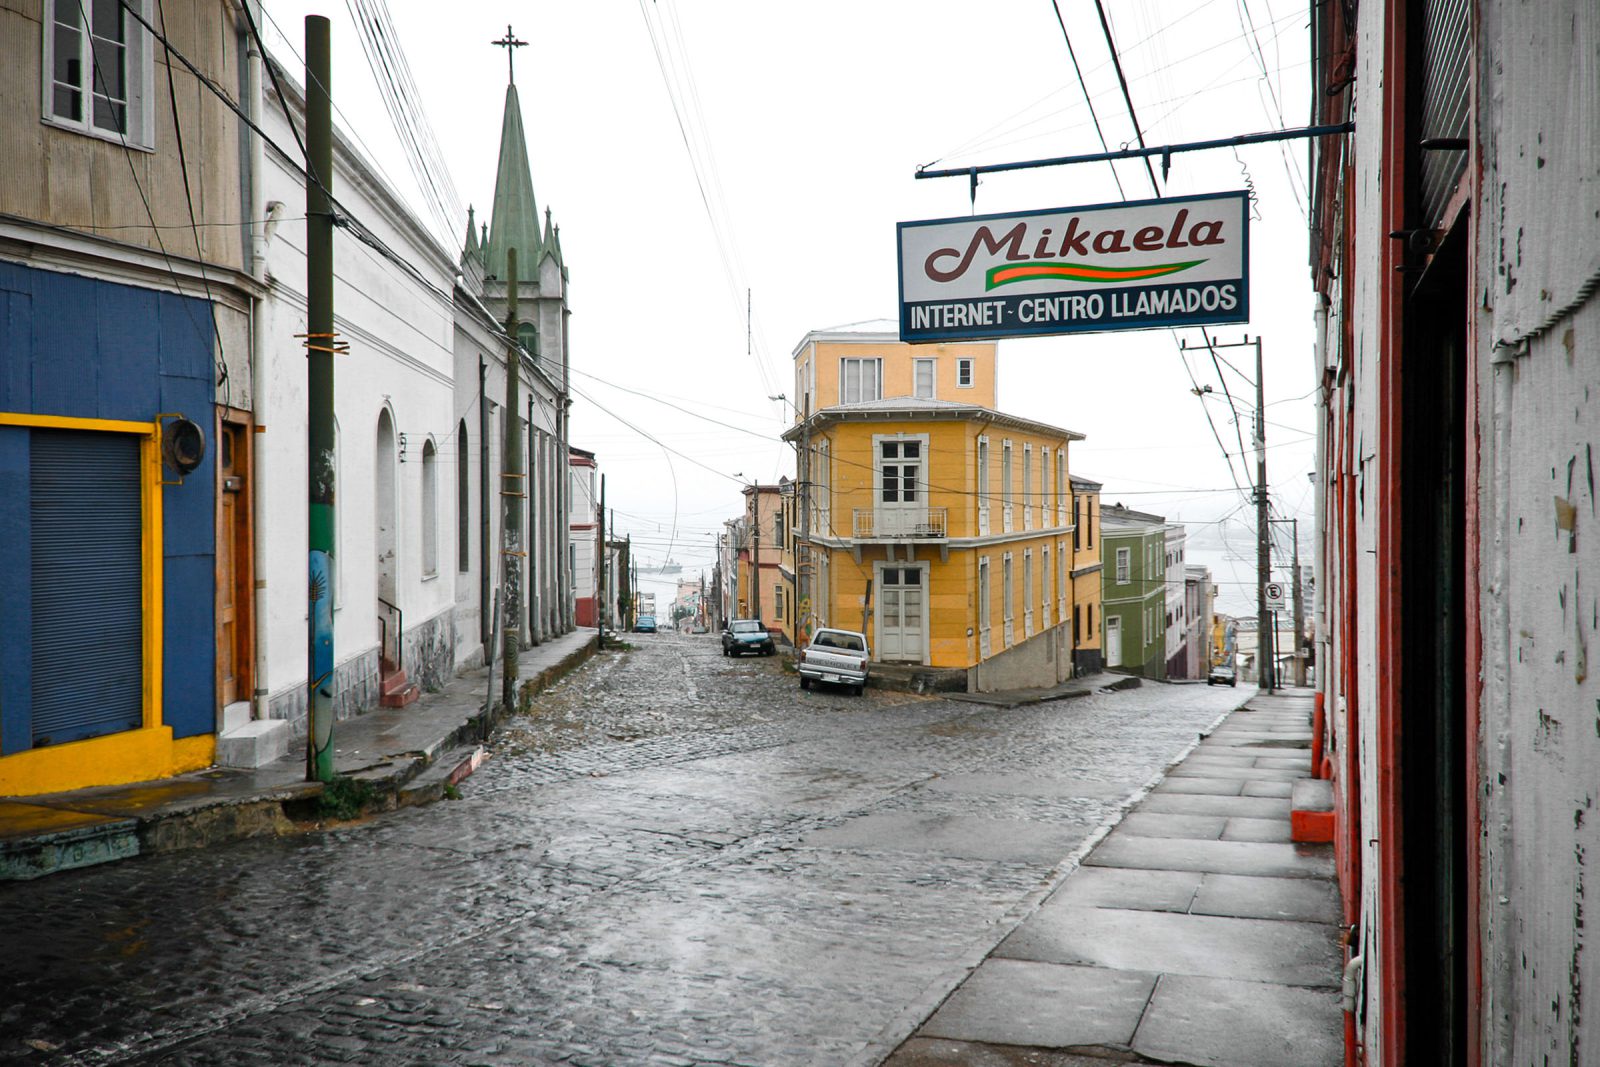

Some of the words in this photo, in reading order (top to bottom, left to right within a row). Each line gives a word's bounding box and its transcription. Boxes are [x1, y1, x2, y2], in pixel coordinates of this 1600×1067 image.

[924, 208, 1225, 283] Mikaela
[911, 301, 1006, 329] INTERNET
[1018, 293, 1104, 323] CENTRO
[1111, 284, 1237, 318] LLAMADOS
